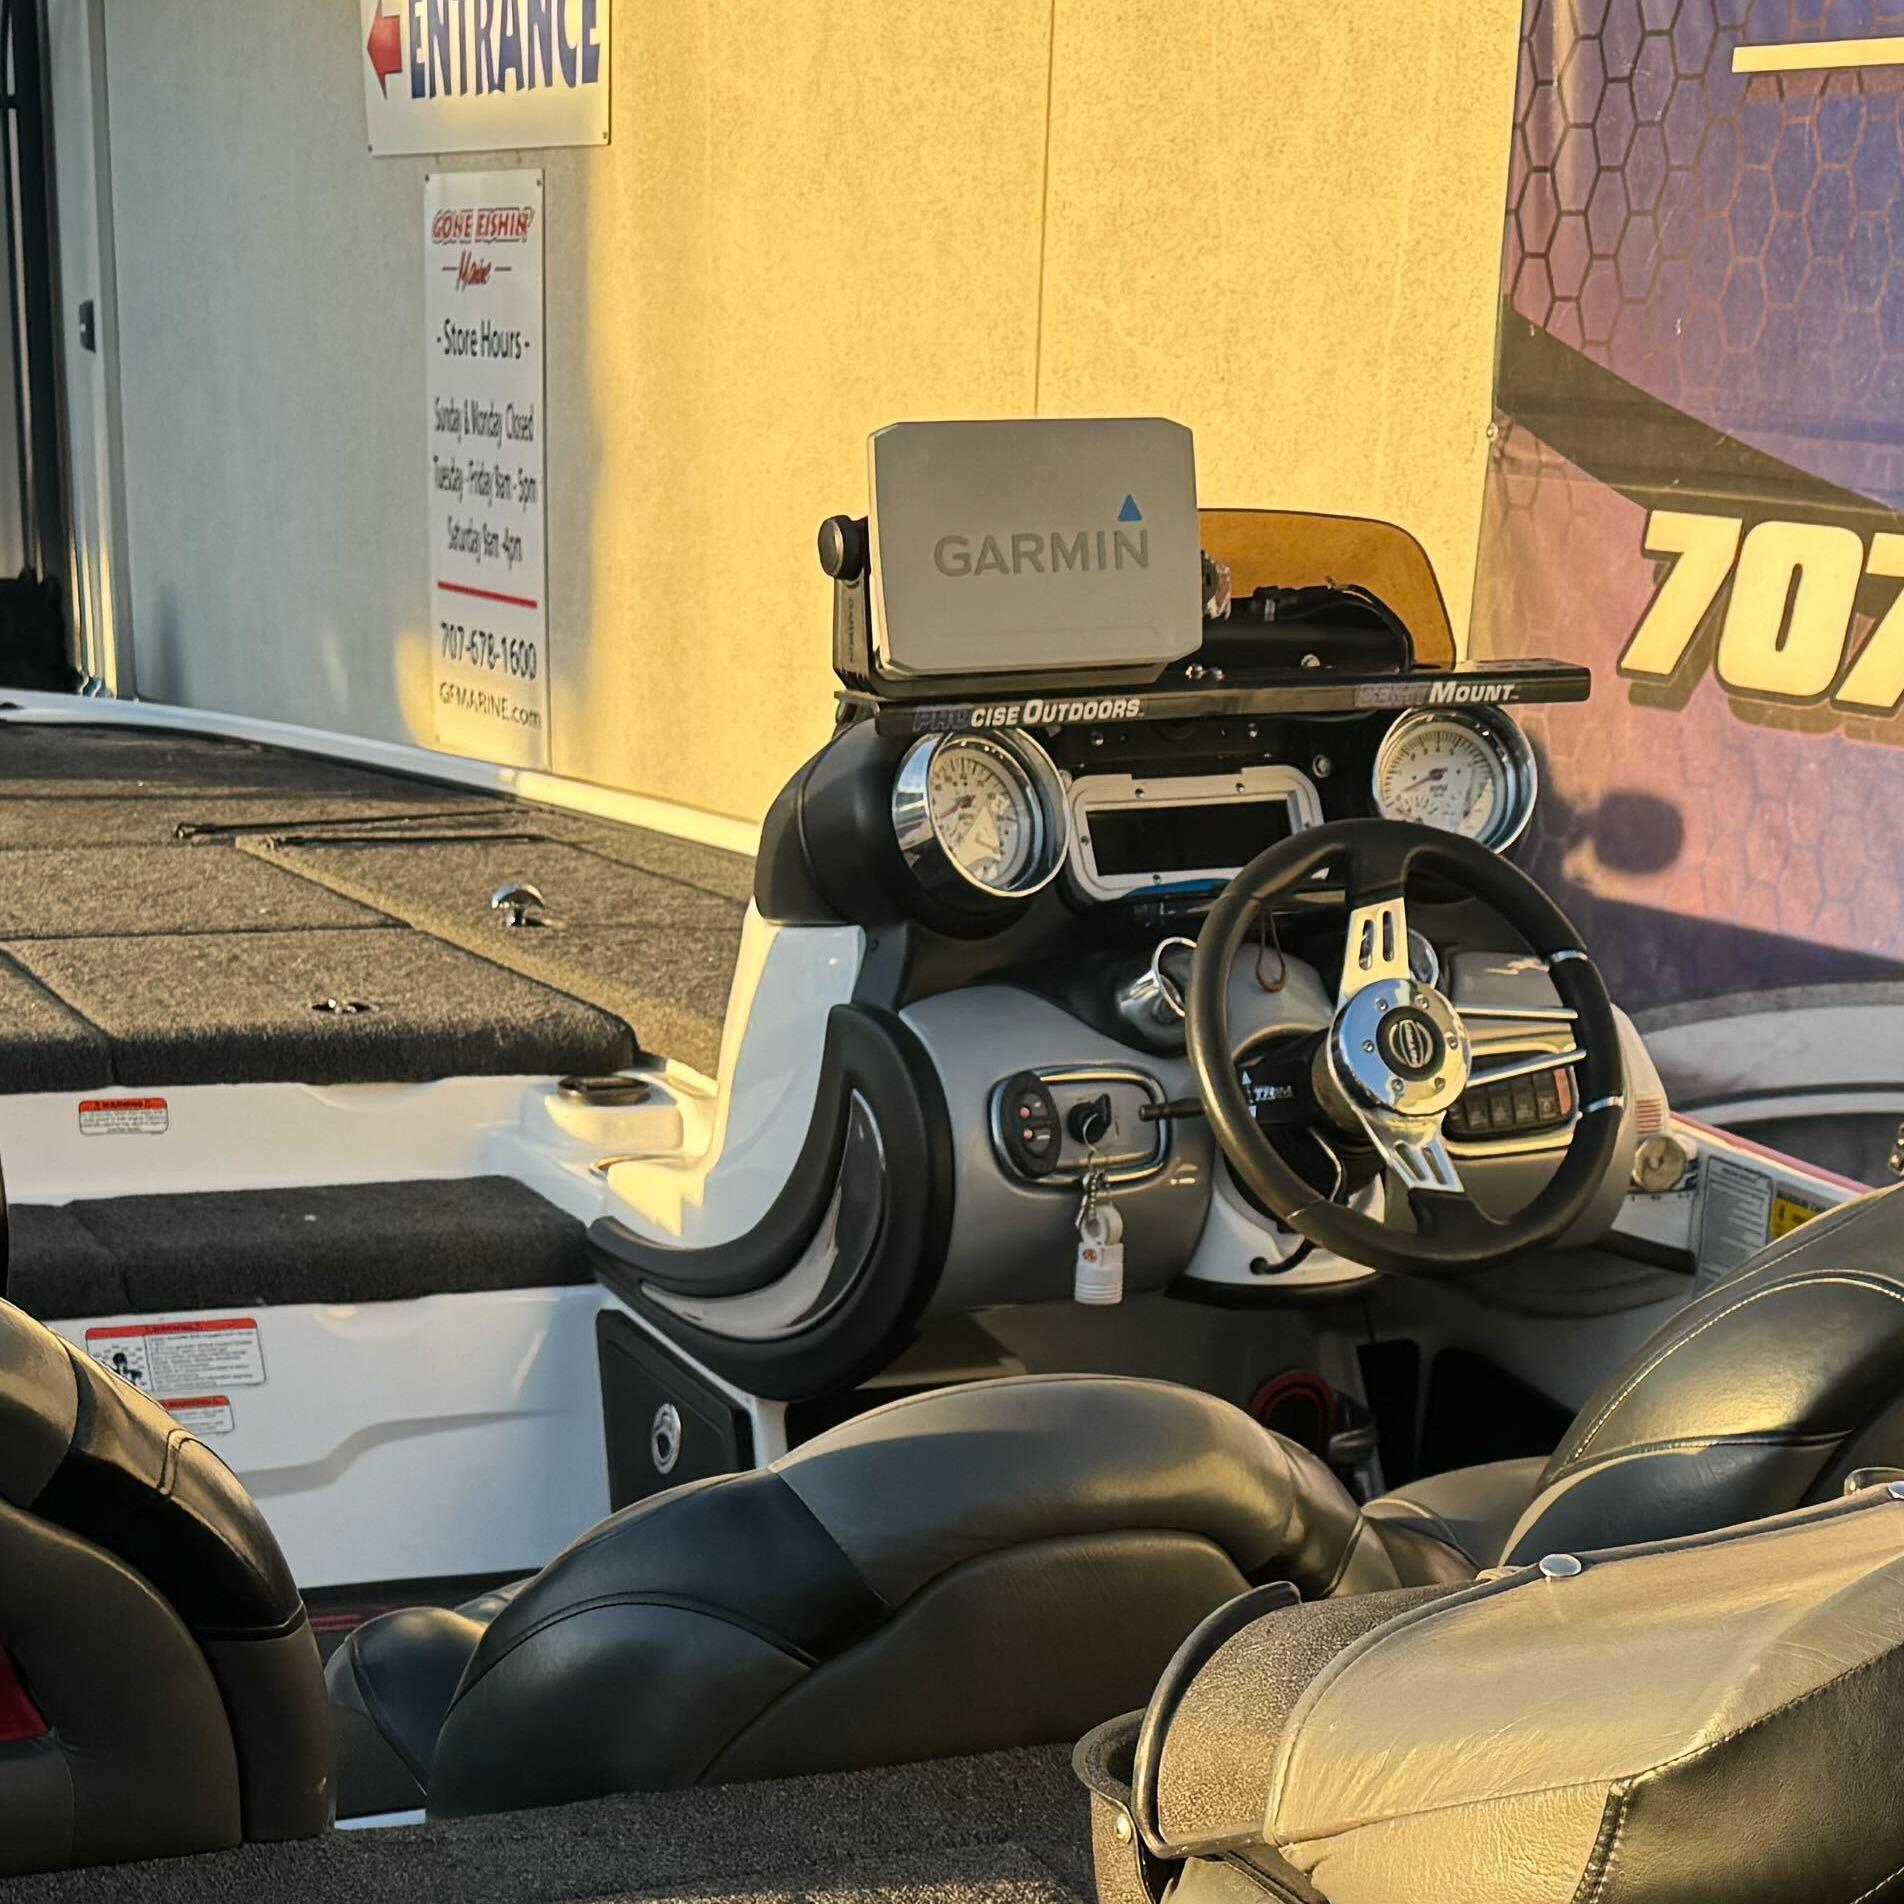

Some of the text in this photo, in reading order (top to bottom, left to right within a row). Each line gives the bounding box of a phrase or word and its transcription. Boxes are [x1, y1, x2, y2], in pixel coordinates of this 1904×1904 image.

[408, 0, 600, 99] ENTRANCE
[431, 207, 474, 243] GONE
[443, 319, 522, 360] Store Hours
[506, 403, 535, 443] Closed
[934, 528, 1149, 578] GARMIN
[440, 621, 537, 681] 707-678-1600
[1022, 698, 1142, 724] OUTDOORS
[1428, 680, 1516, 704] MOUNT
